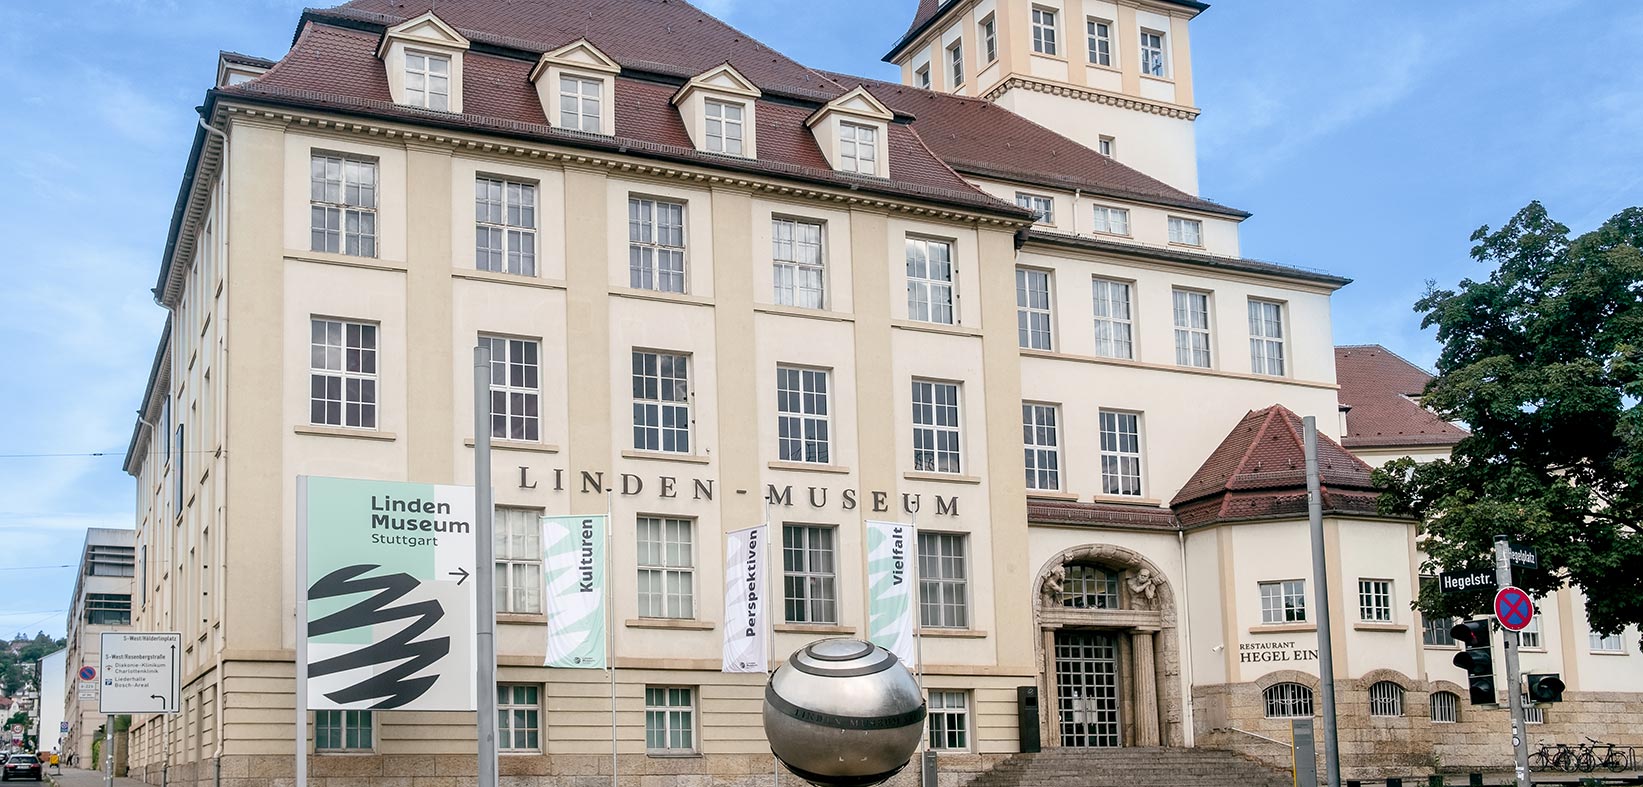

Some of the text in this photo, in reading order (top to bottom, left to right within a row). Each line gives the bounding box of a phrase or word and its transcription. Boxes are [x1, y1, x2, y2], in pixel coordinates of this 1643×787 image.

[518, 466, 715, 501] LINDEN
[767, 483, 960, 516] MUSEUM
[371, 495, 451, 515] Linden
[371, 514, 471, 534] Museum
[371, 533, 438, 548] Stuttgart
[579, 519, 593, 593] Kulturen
[892, 527, 903, 586] Vielfalt
[745, 530, 758, 637] Perspektiven
[1444, 573, 1493, 590] Hegelstr.
[1239, 641, 1295, 650] RESTAURANT
[1240, 650, 1318, 663] HEGEL EIN
